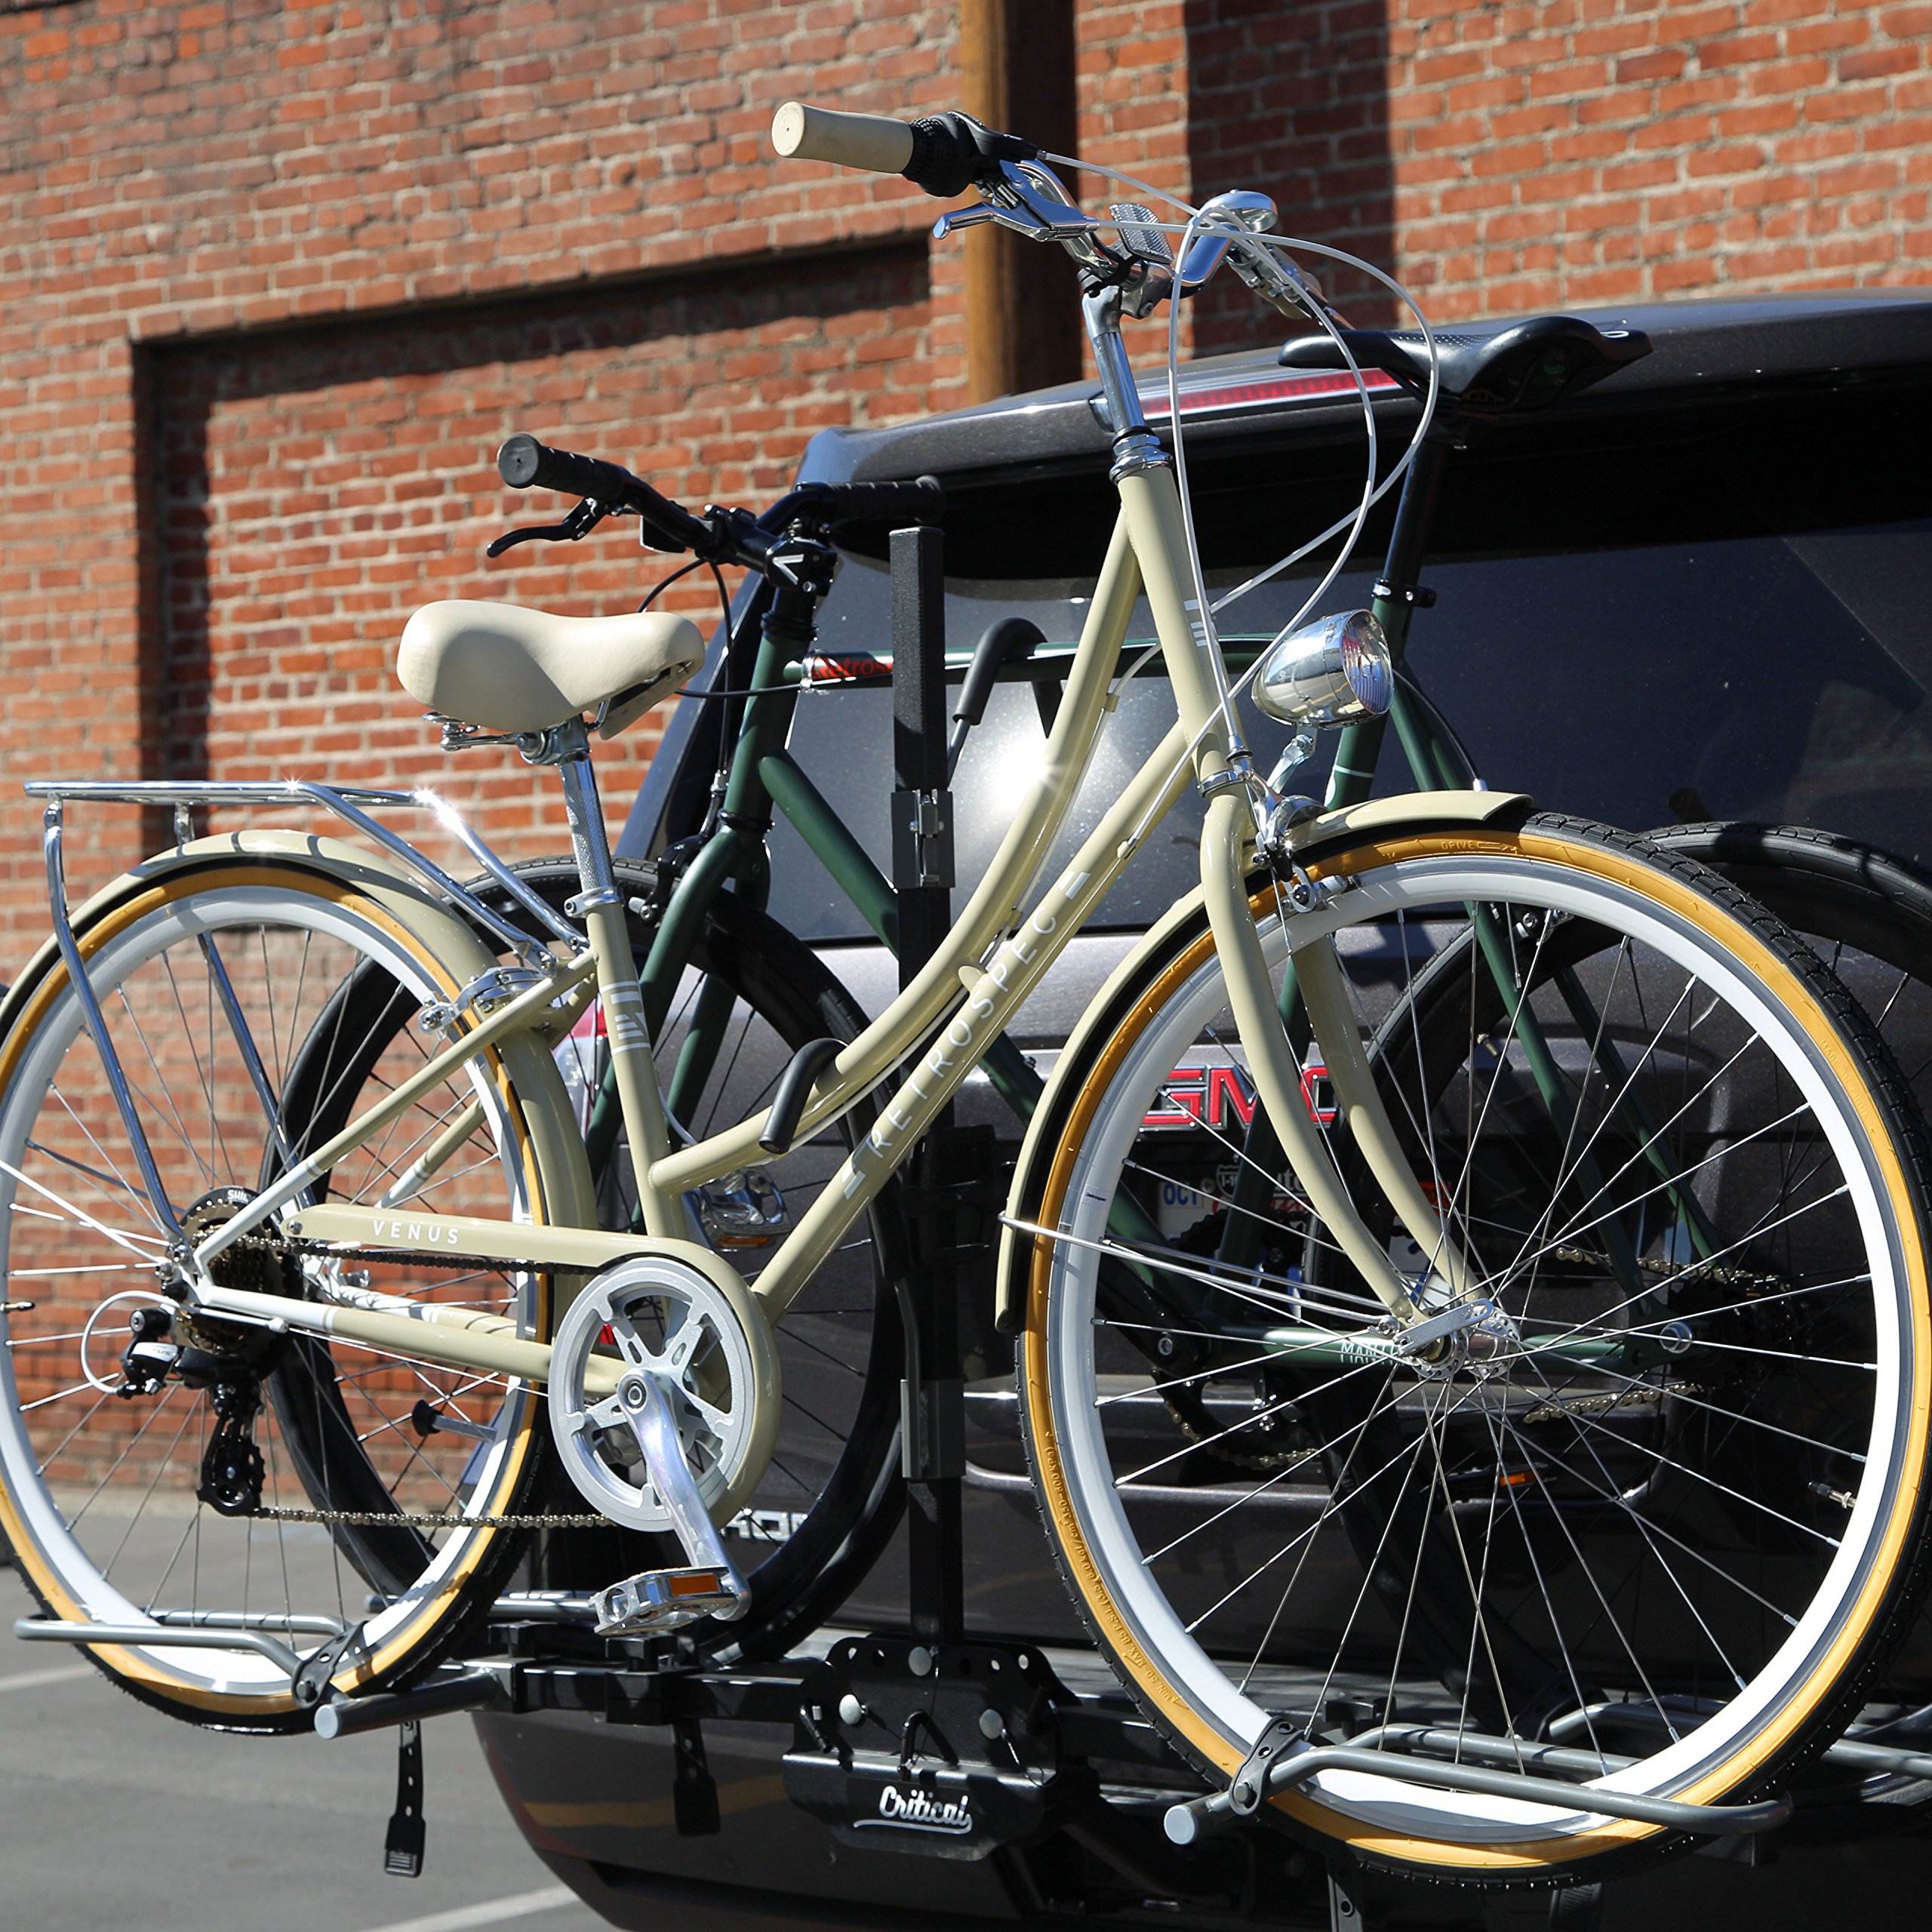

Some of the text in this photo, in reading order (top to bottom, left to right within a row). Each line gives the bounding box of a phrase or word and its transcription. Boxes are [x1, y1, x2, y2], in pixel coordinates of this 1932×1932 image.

[811, 656, 893, 680] Retros
[1441, 840, 1474, 851] DRIVE
[866, 906, 1057, 1158] RETROSPEC
[1140, 1065, 1336, 1131] GMC
[373, 1219, 459, 1244] VENUS
[878, 1785, 973, 1829] Critical
